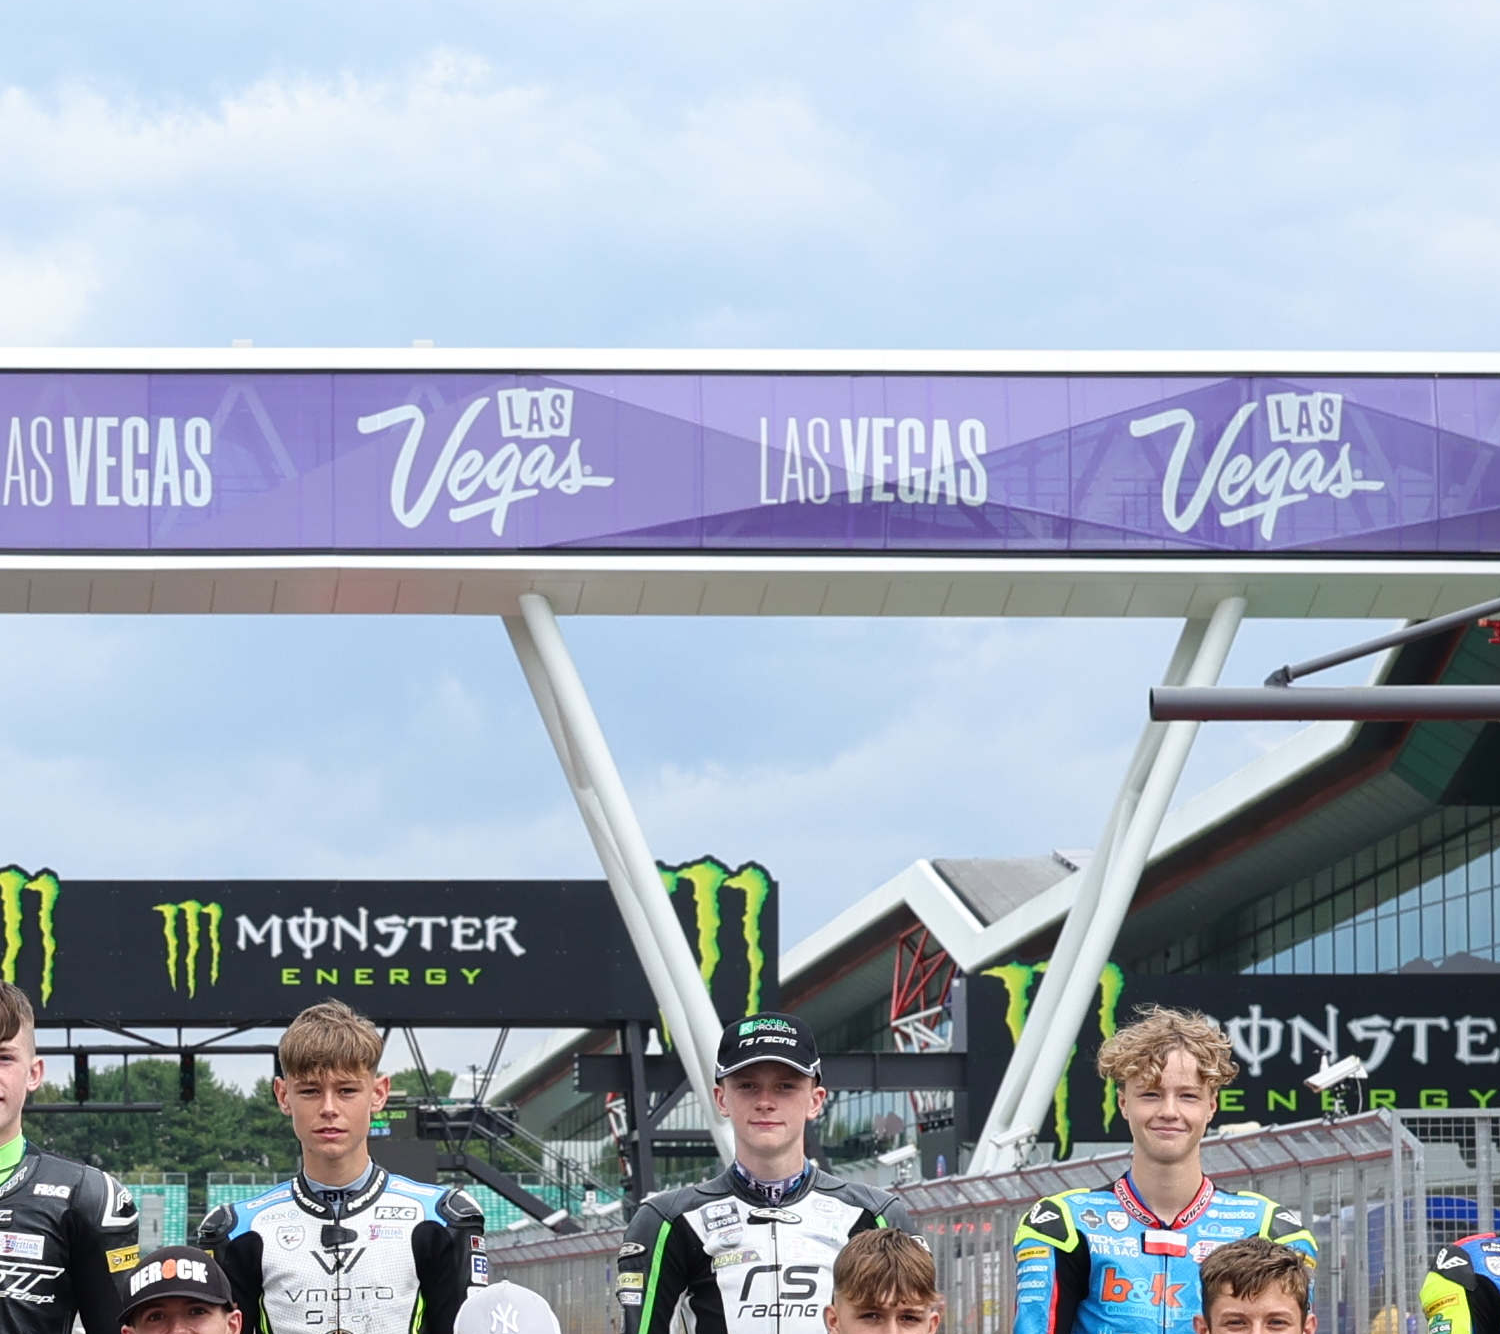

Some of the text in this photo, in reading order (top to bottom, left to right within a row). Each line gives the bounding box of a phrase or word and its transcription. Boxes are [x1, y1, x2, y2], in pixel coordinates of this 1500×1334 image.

[501, 392, 573, 436] LAS
[1269, 395, 1341, 441] LAS
[64, 416, 211, 508] VEGAS
[357, 396, 614, 536] Vegas
[761, 416, 987, 507] LAS VEGAS
[1131, 407, 1385, 539] Vegas
[236, 908, 526, 959] MONSTER
[281, 968, 483, 985] ENERGY
[754, 1025, 797, 1034] PROJECTS
[756, 1038, 797, 1046] racing
[33, 1184, 70, 1198] R&G
[376, 1208, 417, 1220] R&G
[738, 1303, 818, 1318] racing
